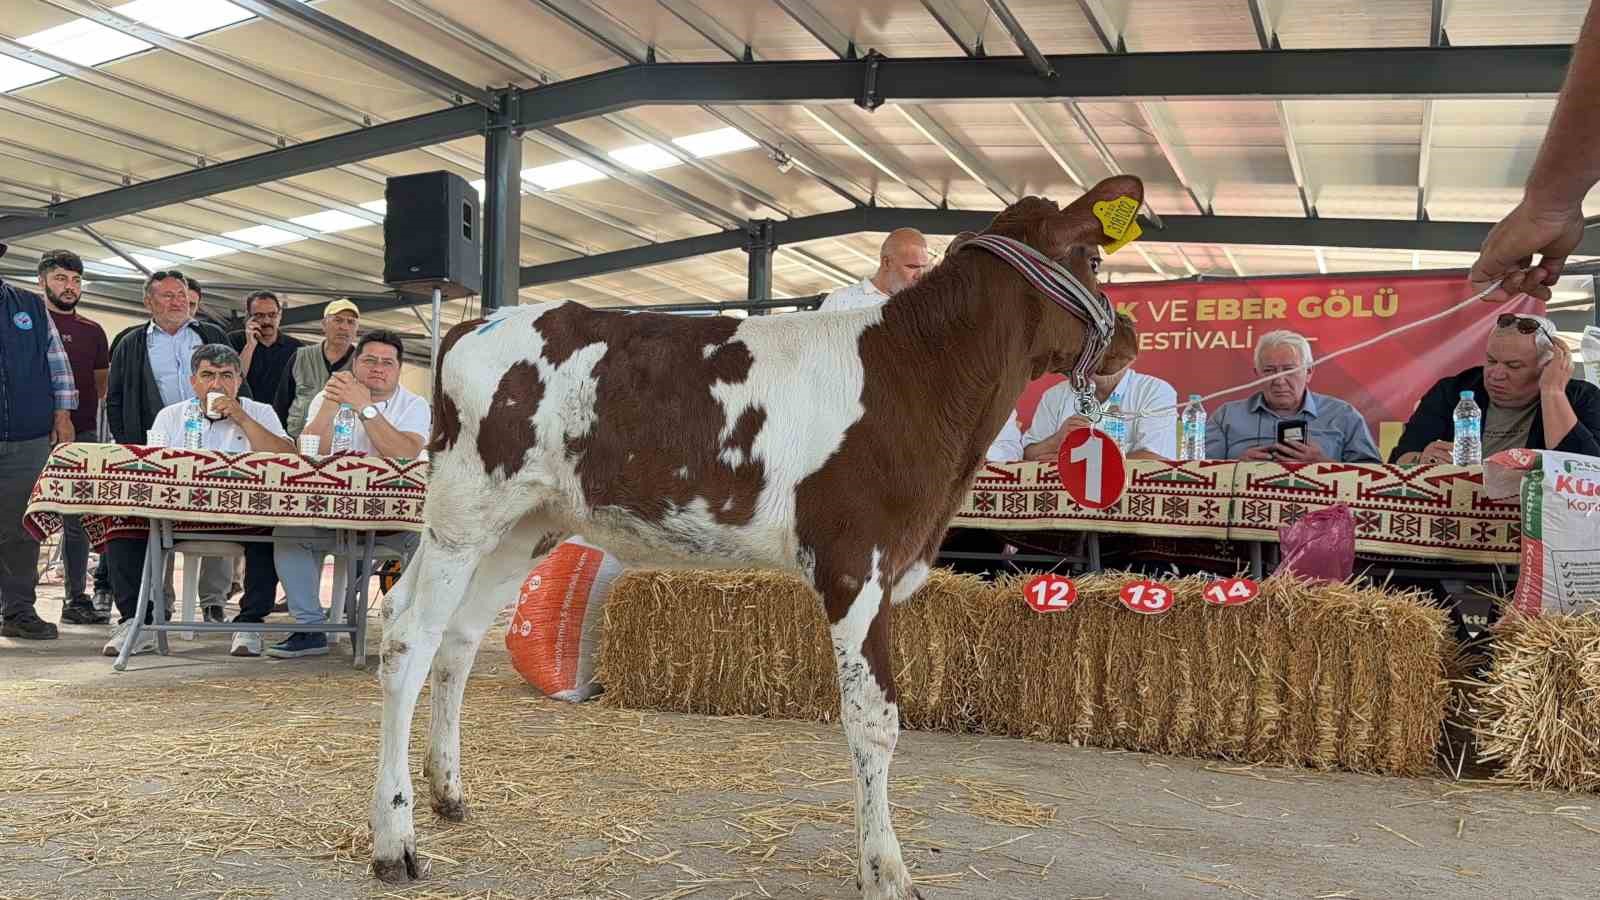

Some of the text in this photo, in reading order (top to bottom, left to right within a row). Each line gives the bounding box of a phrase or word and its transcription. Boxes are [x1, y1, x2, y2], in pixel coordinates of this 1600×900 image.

[1147, 300, 1188, 321] VE
[1196, 298, 1287, 320] EBER
[1298, 288, 1398, 318] GÖLÜ
[1136, 326, 1252, 351] ESTİVALİ
[1070, 436, 1103, 504] 1
[1031, 581, 1068, 606] 12
[1127, 585, 1167, 609] 13
[1207, 581, 1250, 602] 14
